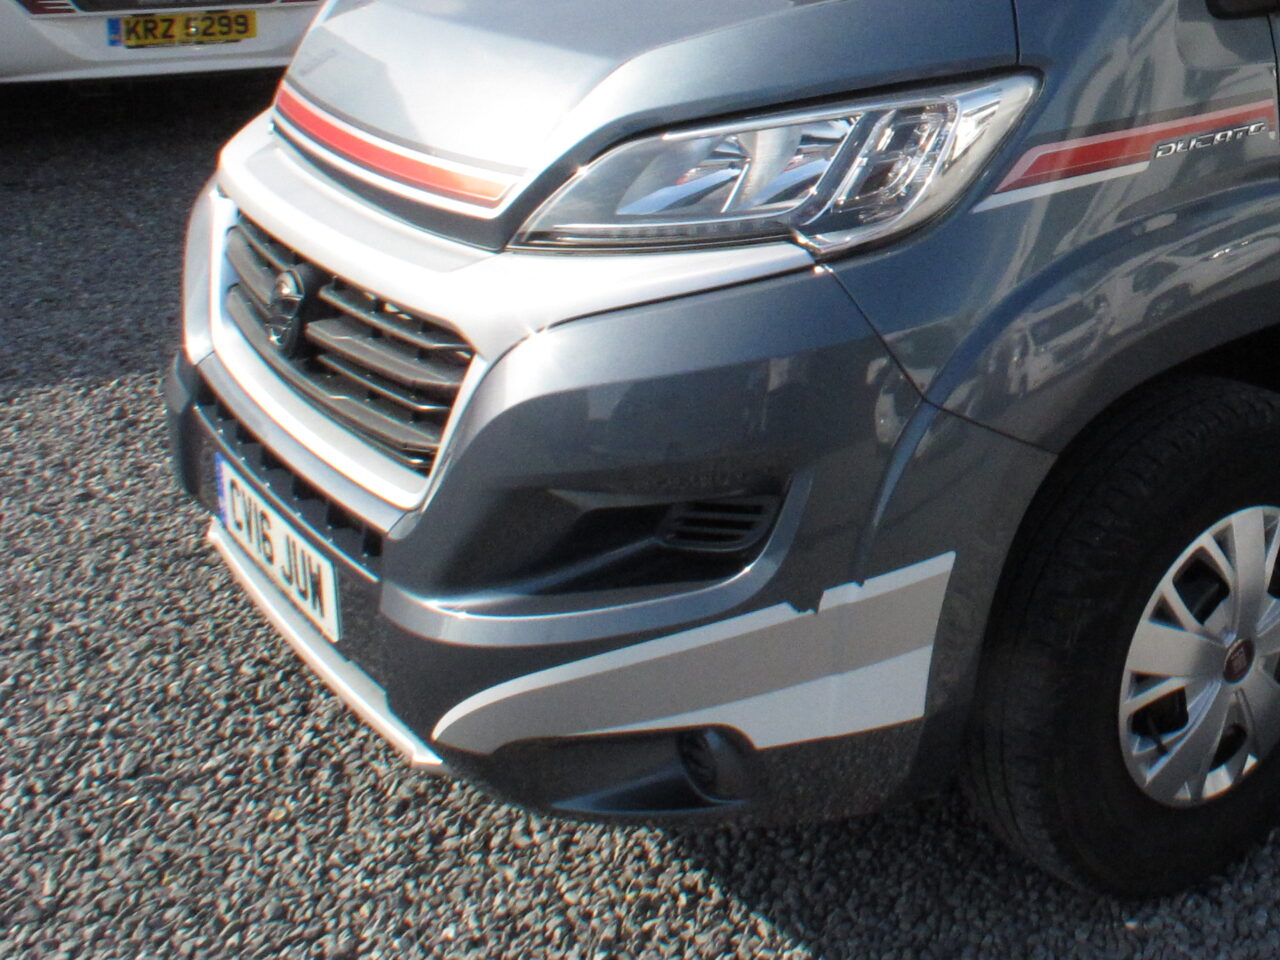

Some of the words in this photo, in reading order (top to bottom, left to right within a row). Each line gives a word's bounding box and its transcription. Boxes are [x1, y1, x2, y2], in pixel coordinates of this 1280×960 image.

[123, 18, 176, 40] KRZ
[184, 14, 249, 38] 5299
[1155, 122, 1266, 158] DUCATO
[229, 478, 275, 566] CV16
